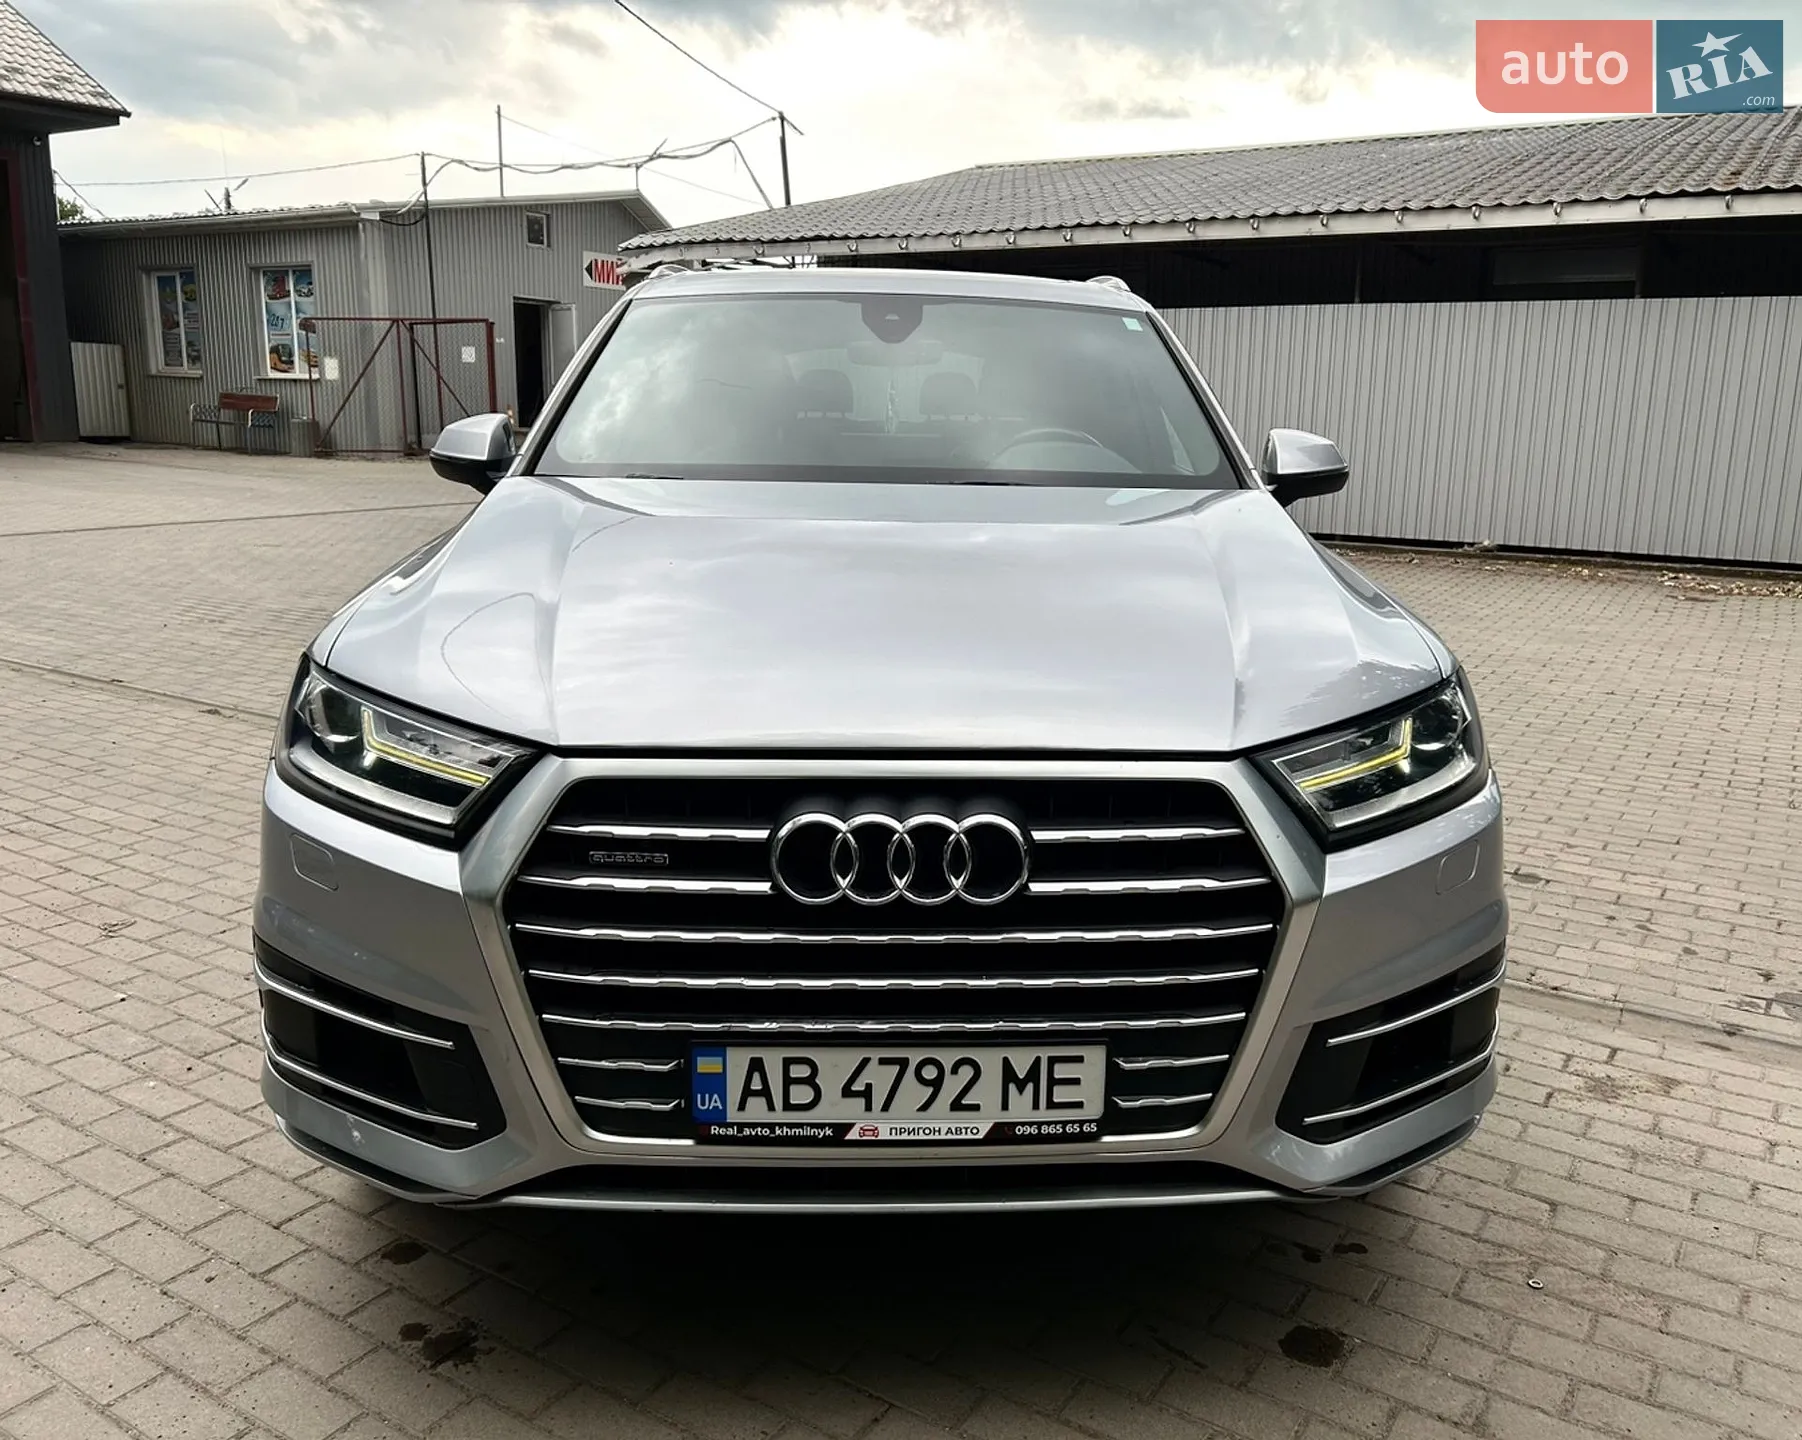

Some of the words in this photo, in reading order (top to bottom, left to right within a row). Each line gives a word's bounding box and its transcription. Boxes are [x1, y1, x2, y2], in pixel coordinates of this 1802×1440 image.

[592, 853, 665, 864] quattro
[736, 1055, 823, 1113] AB
[840, 1055, 983, 1113] 4792
[1000, 1054, 1085, 1112] ME
[696, 1093, 723, 1111] UA
[710, 1125, 834, 1138] Real_avto_khmilnyk
[889, 1126, 941, 1137] ПРИГОН
[944, 1126, 980, 1136] АВТО
[1015, 1124, 1039, 1136] 096
[1040, 1123, 1064, 1135] 865
[1065, 1123, 1081, 1134] 65
[1082, 1122, 1098, 1133] 65
